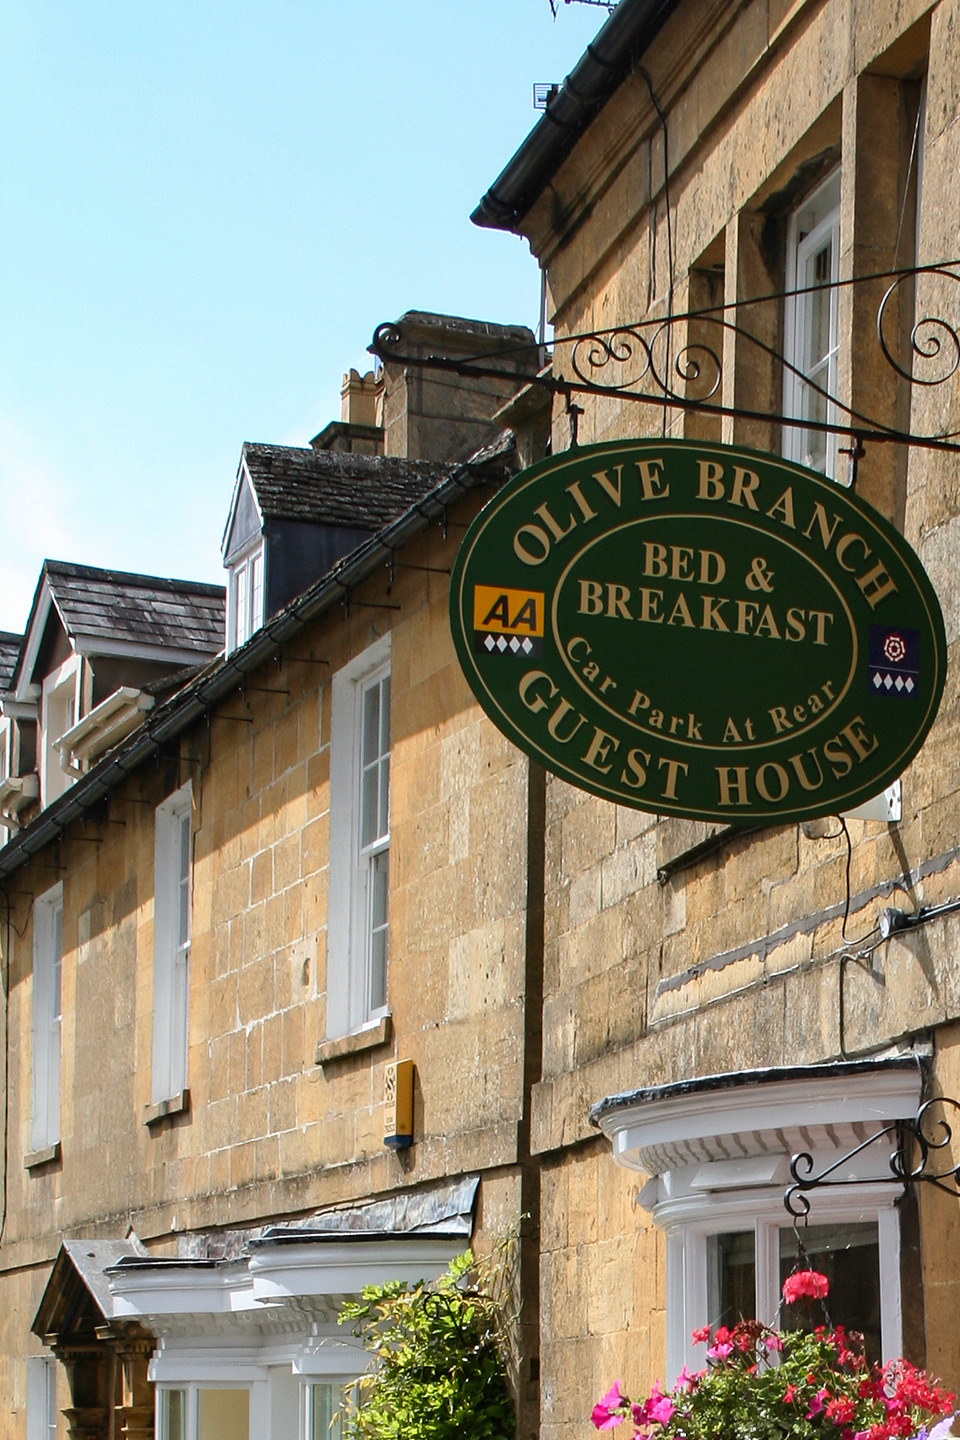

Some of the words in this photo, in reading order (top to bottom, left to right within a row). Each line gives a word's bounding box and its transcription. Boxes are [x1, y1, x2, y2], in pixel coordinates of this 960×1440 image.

[513, 458, 671, 566] OLIVE
[695, 460, 899, 611] BRANCH
[642, 542, 726, 585] BED
[744, 557, 776, 593] &
[482, 594, 538, 632] AA
[576, 579, 834, 646] BREAKFAST
[566, 636, 618, 695] Car
[627, 690, 704, 741] Park
[722, 716, 756, 744] At
[767, 680, 836, 736] Rear
[518, 670, 689, 801] GUEST
[715, 715, 881, 807] HOUSE
